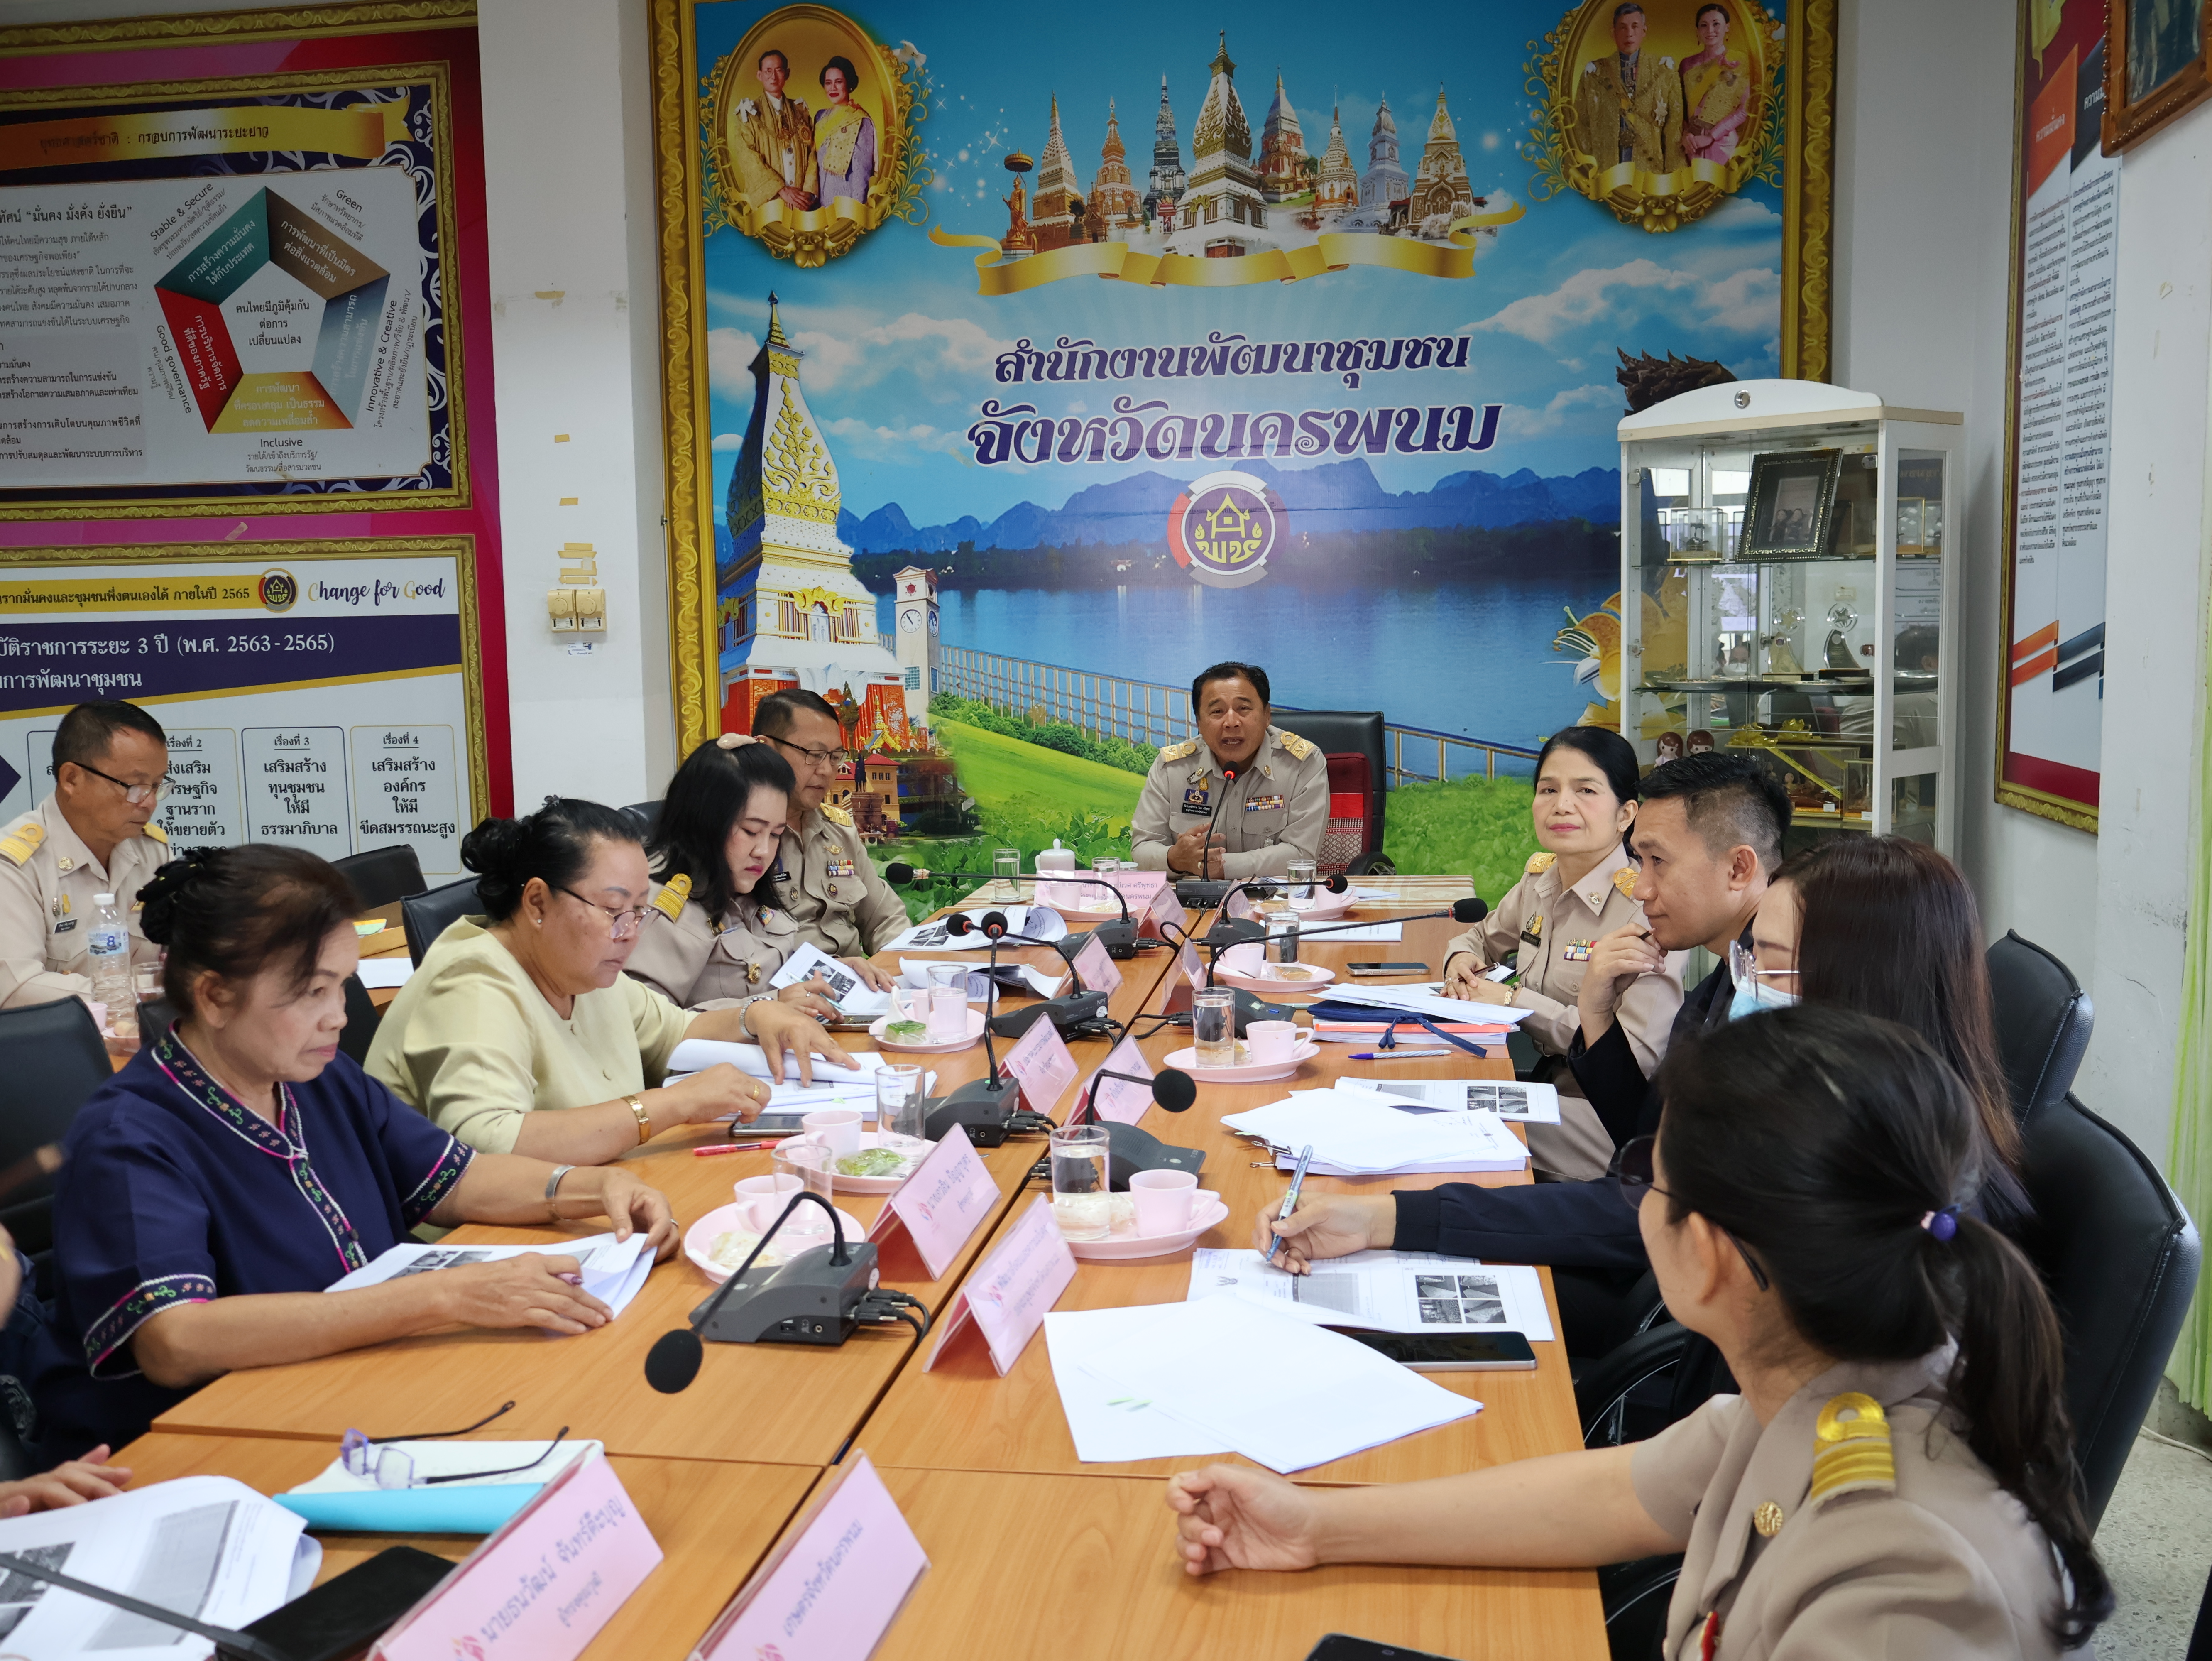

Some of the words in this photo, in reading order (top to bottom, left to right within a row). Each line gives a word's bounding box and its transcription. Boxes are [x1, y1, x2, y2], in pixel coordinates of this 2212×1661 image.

[138, 126, 269, 144] กรอบการพัฒนาระยะยาว
[336, 189, 362, 213] Green
[150, 215, 177, 240] Stable
[176, 208, 186, 217] &
[184, 184, 213, 210] Secure
[188, 220, 256, 282] การสร้างความมั่นคง
[281, 220, 356, 276] การพัฒนาที่เป็นมิตร
[206, 242, 255, 286] ให้กับประเทศ
[284, 242, 337, 283] ต่อสิ่งแวดล้อม
[236, 299, 309, 315] คนไทยมีภูมิคุ้มกัน
[259, 318, 288, 328] ต่อการ
[249, 332, 301, 346] เปลี่ยนแปลง
[195, 315, 227, 391] การบริหารจัดการ
[366, 358, 385, 412] Innovative
[381, 300, 397, 343] Creative
[995, 331, 1471, 389] สำนักงานพัฒนาชุมชน
[157, 325, 172, 353] Good
[165, 355, 192, 414] governance
[257, 382, 300, 393] การพัฒนา
[967, 396, 1503, 464] จังหวัดนครพนม
[261, 438, 303, 448] Inclusive
[245, 461, 321, 473] วัฒนธรรม/สื่อสารมวลชน
[173, 585, 217, 601] ภายในปี
[222, 588, 250, 599] 2565
[308, 581, 370, 605] Change
[374, 579, 400, 606] for
[404, 578, 446, 600] Good
[138, 637, 148, 654] 3
[154, 633, 168, 654] ปี
[177, 635, 219, 656] (พ.ศ.
[274, 734, 300, 746] เรื่องที่
[383, 733, 409, 745] เรื่องที่
[264, 757, 326, 773] เสริมสร้าง
[372, 756, 435, 772] เสริมสร้าง
[268, 783, 325, 799] ทุนชุมชน
[384, 778, 426, 792] องค์กร
[166, 805, 215, 820] ฐานราก
[284, 797, 310, 814] ให้มี
[392, 796, 418, 813] ให้มี
[261, 821, 338, 835] ธรรมาภิบาล
[360, 820, 455, 839] ขีดสมรรถนะสูง
[107, 935, 115, 946] 8
